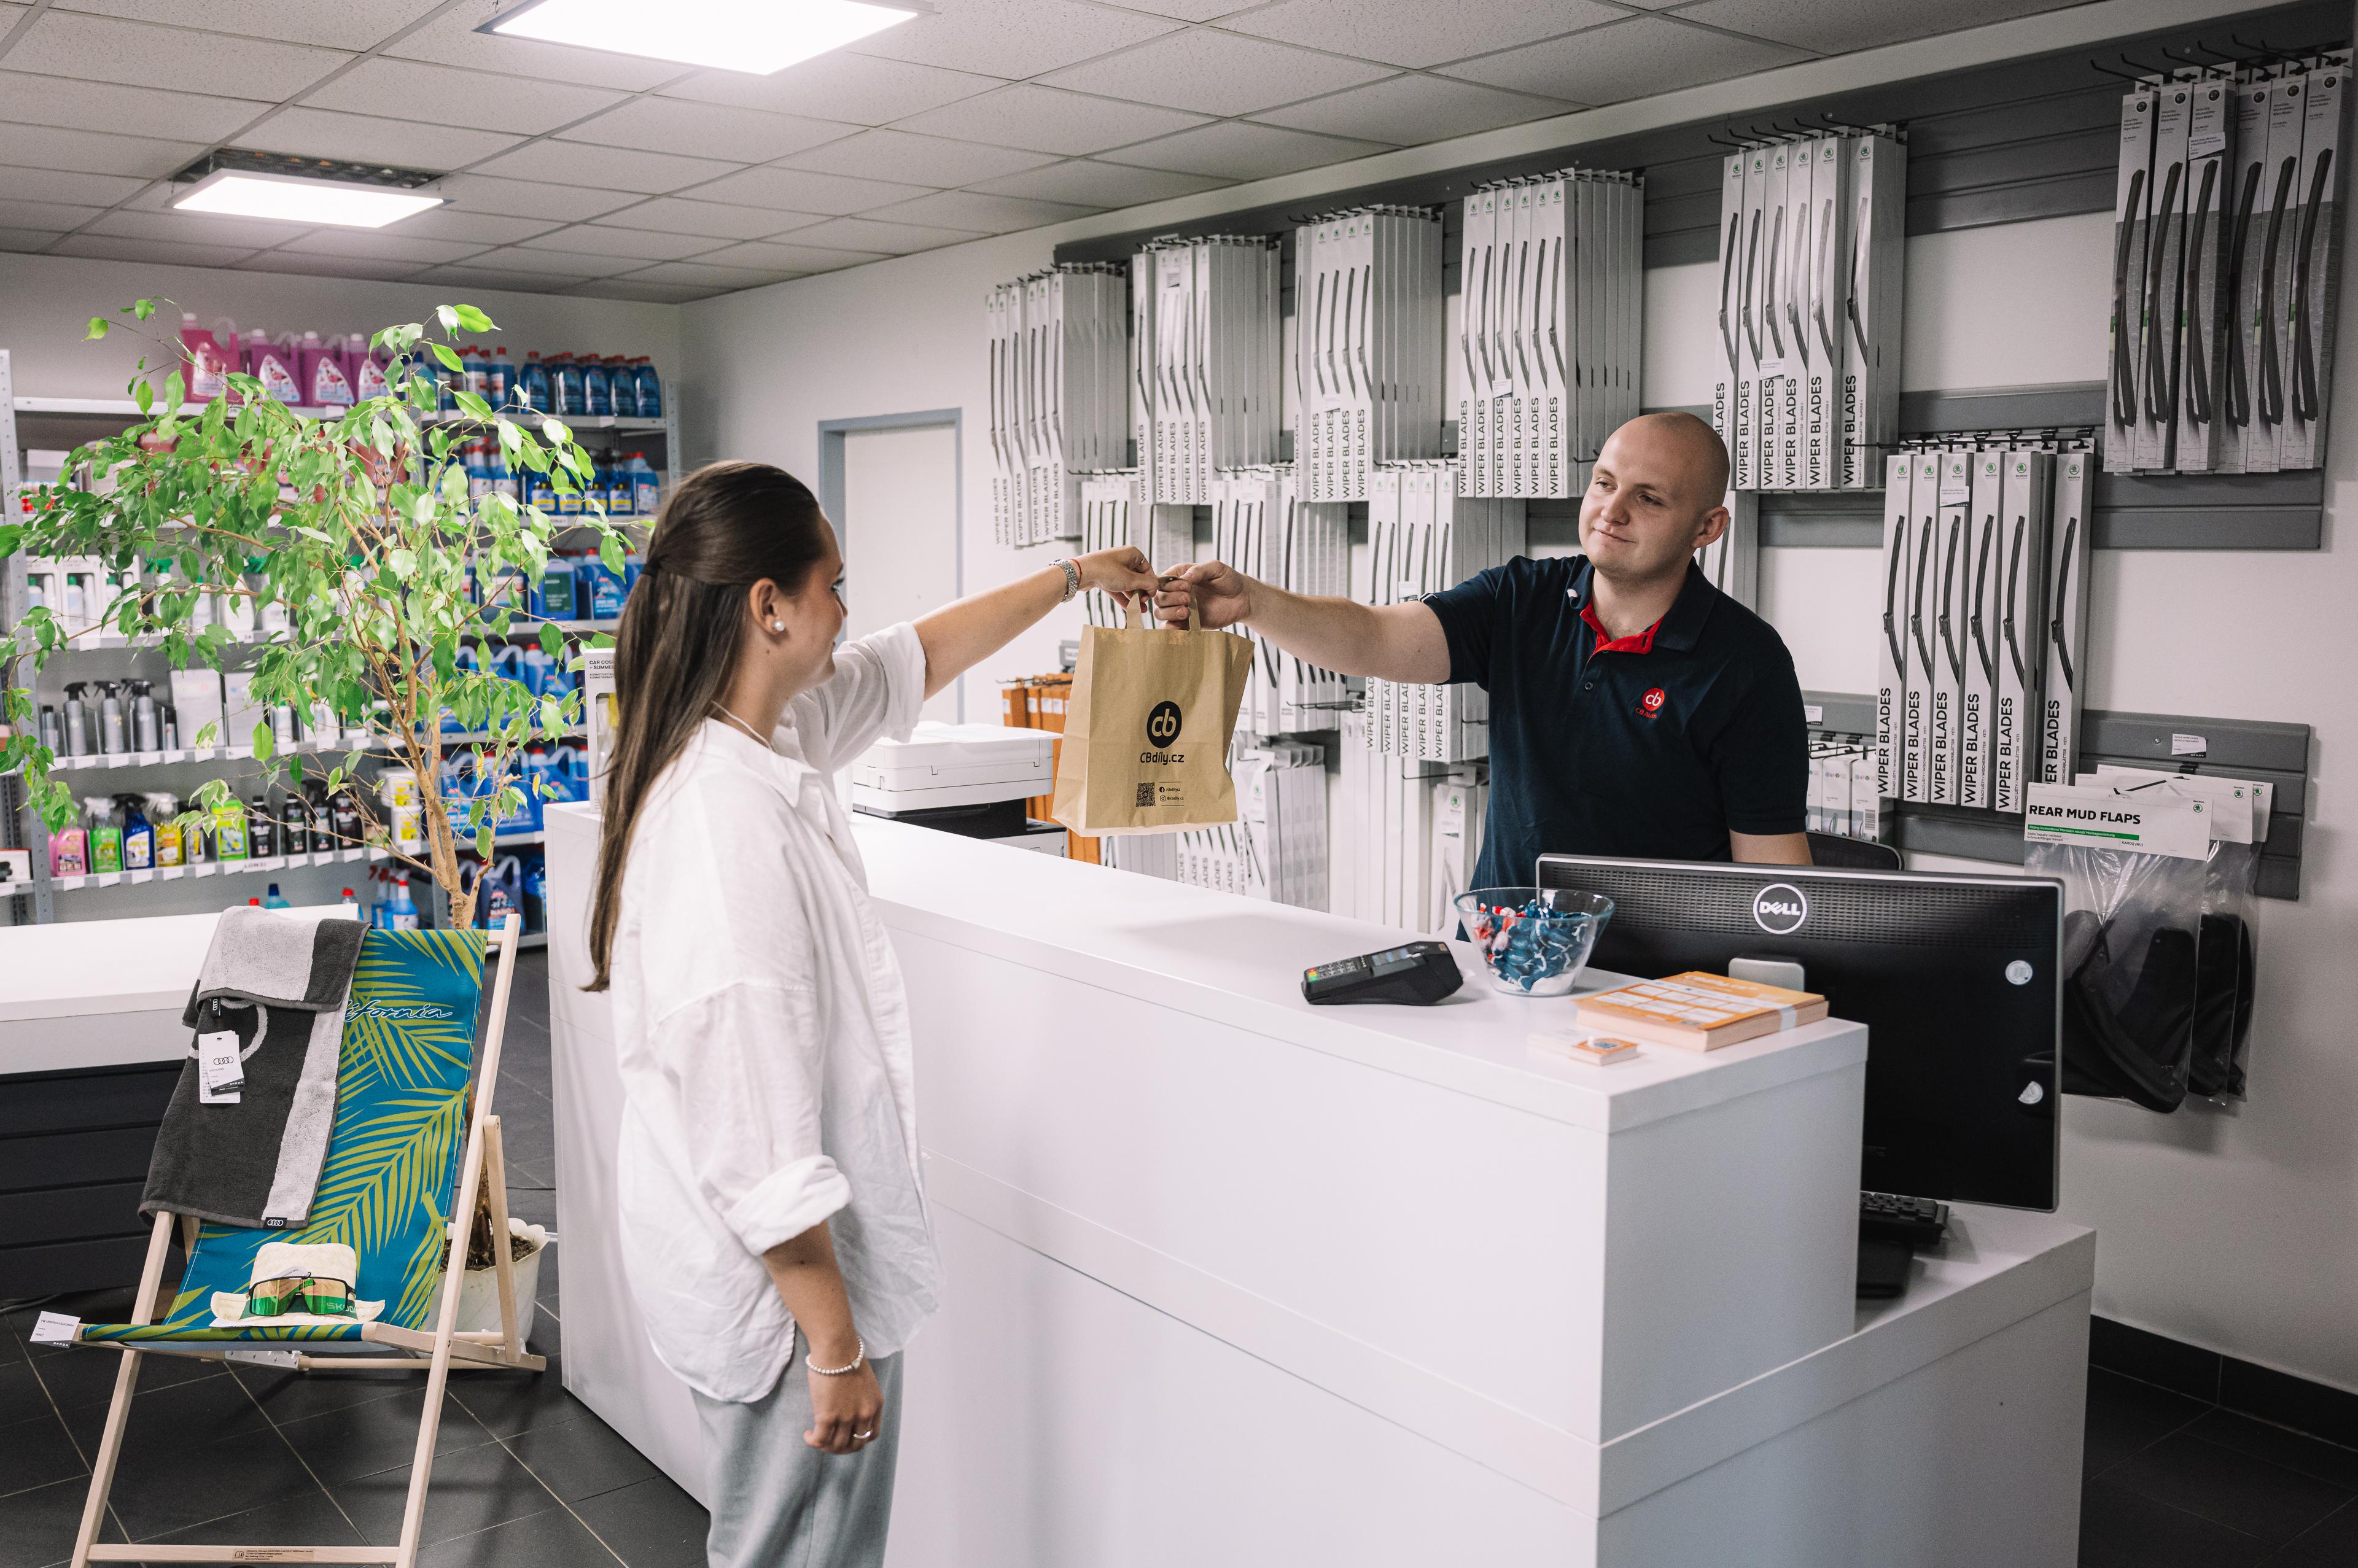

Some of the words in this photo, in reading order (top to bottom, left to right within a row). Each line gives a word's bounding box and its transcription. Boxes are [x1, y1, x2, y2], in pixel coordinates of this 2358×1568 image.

[1740, 381, 1749, 436] BLADES
[1765, 378, 1774, 435] BLADES
[1786, 378, 1796, 435] BLADES
[1811, 376, 1821, 433] BLADES
[1845, 375, 1856, 432] BLADES
[1738, 441, 1748, 486] WIPER
[1764, 440, 1773, 486] WIPER
[1786, 440, 1796, 486] WIPER
[1810, 438, 1821, 485] WIPER
[1843, 437, 1854, 485] WIPER
[1151, 708, 1176, 736] cb
[1879, 688, 1890, 743] BLADES
[1909, 691, 1920, 747] BLADES
[1936, 693, 1947, 748] BLADES
[1967, 694, 1979, 751] BLADES
[2000, 697, 2012, 756] BLADES
[2047, 701, 2059, 759] BLADES
[1140, 752, 1184, 765] CBdíly.cz
[1878, 748, 1889, 793] WIPER
[1907, 753, 1918, 798] WIPER
[1934, 754, 1946, 799] WIPER
[1964, 756, 1977, 803] WIPER
[1999, 761, 2010, 809] WIPER
[2029, 805, 2063, 817] REAR
[2066, 809, 2096, 820] MUD
[2100, 812, 2141, 824] FLAPS
[1759, 901, 1801, 916] DELL
[344, 999, 453, 1023] ifornia
[327, 1302, 356, 1313] SKD
